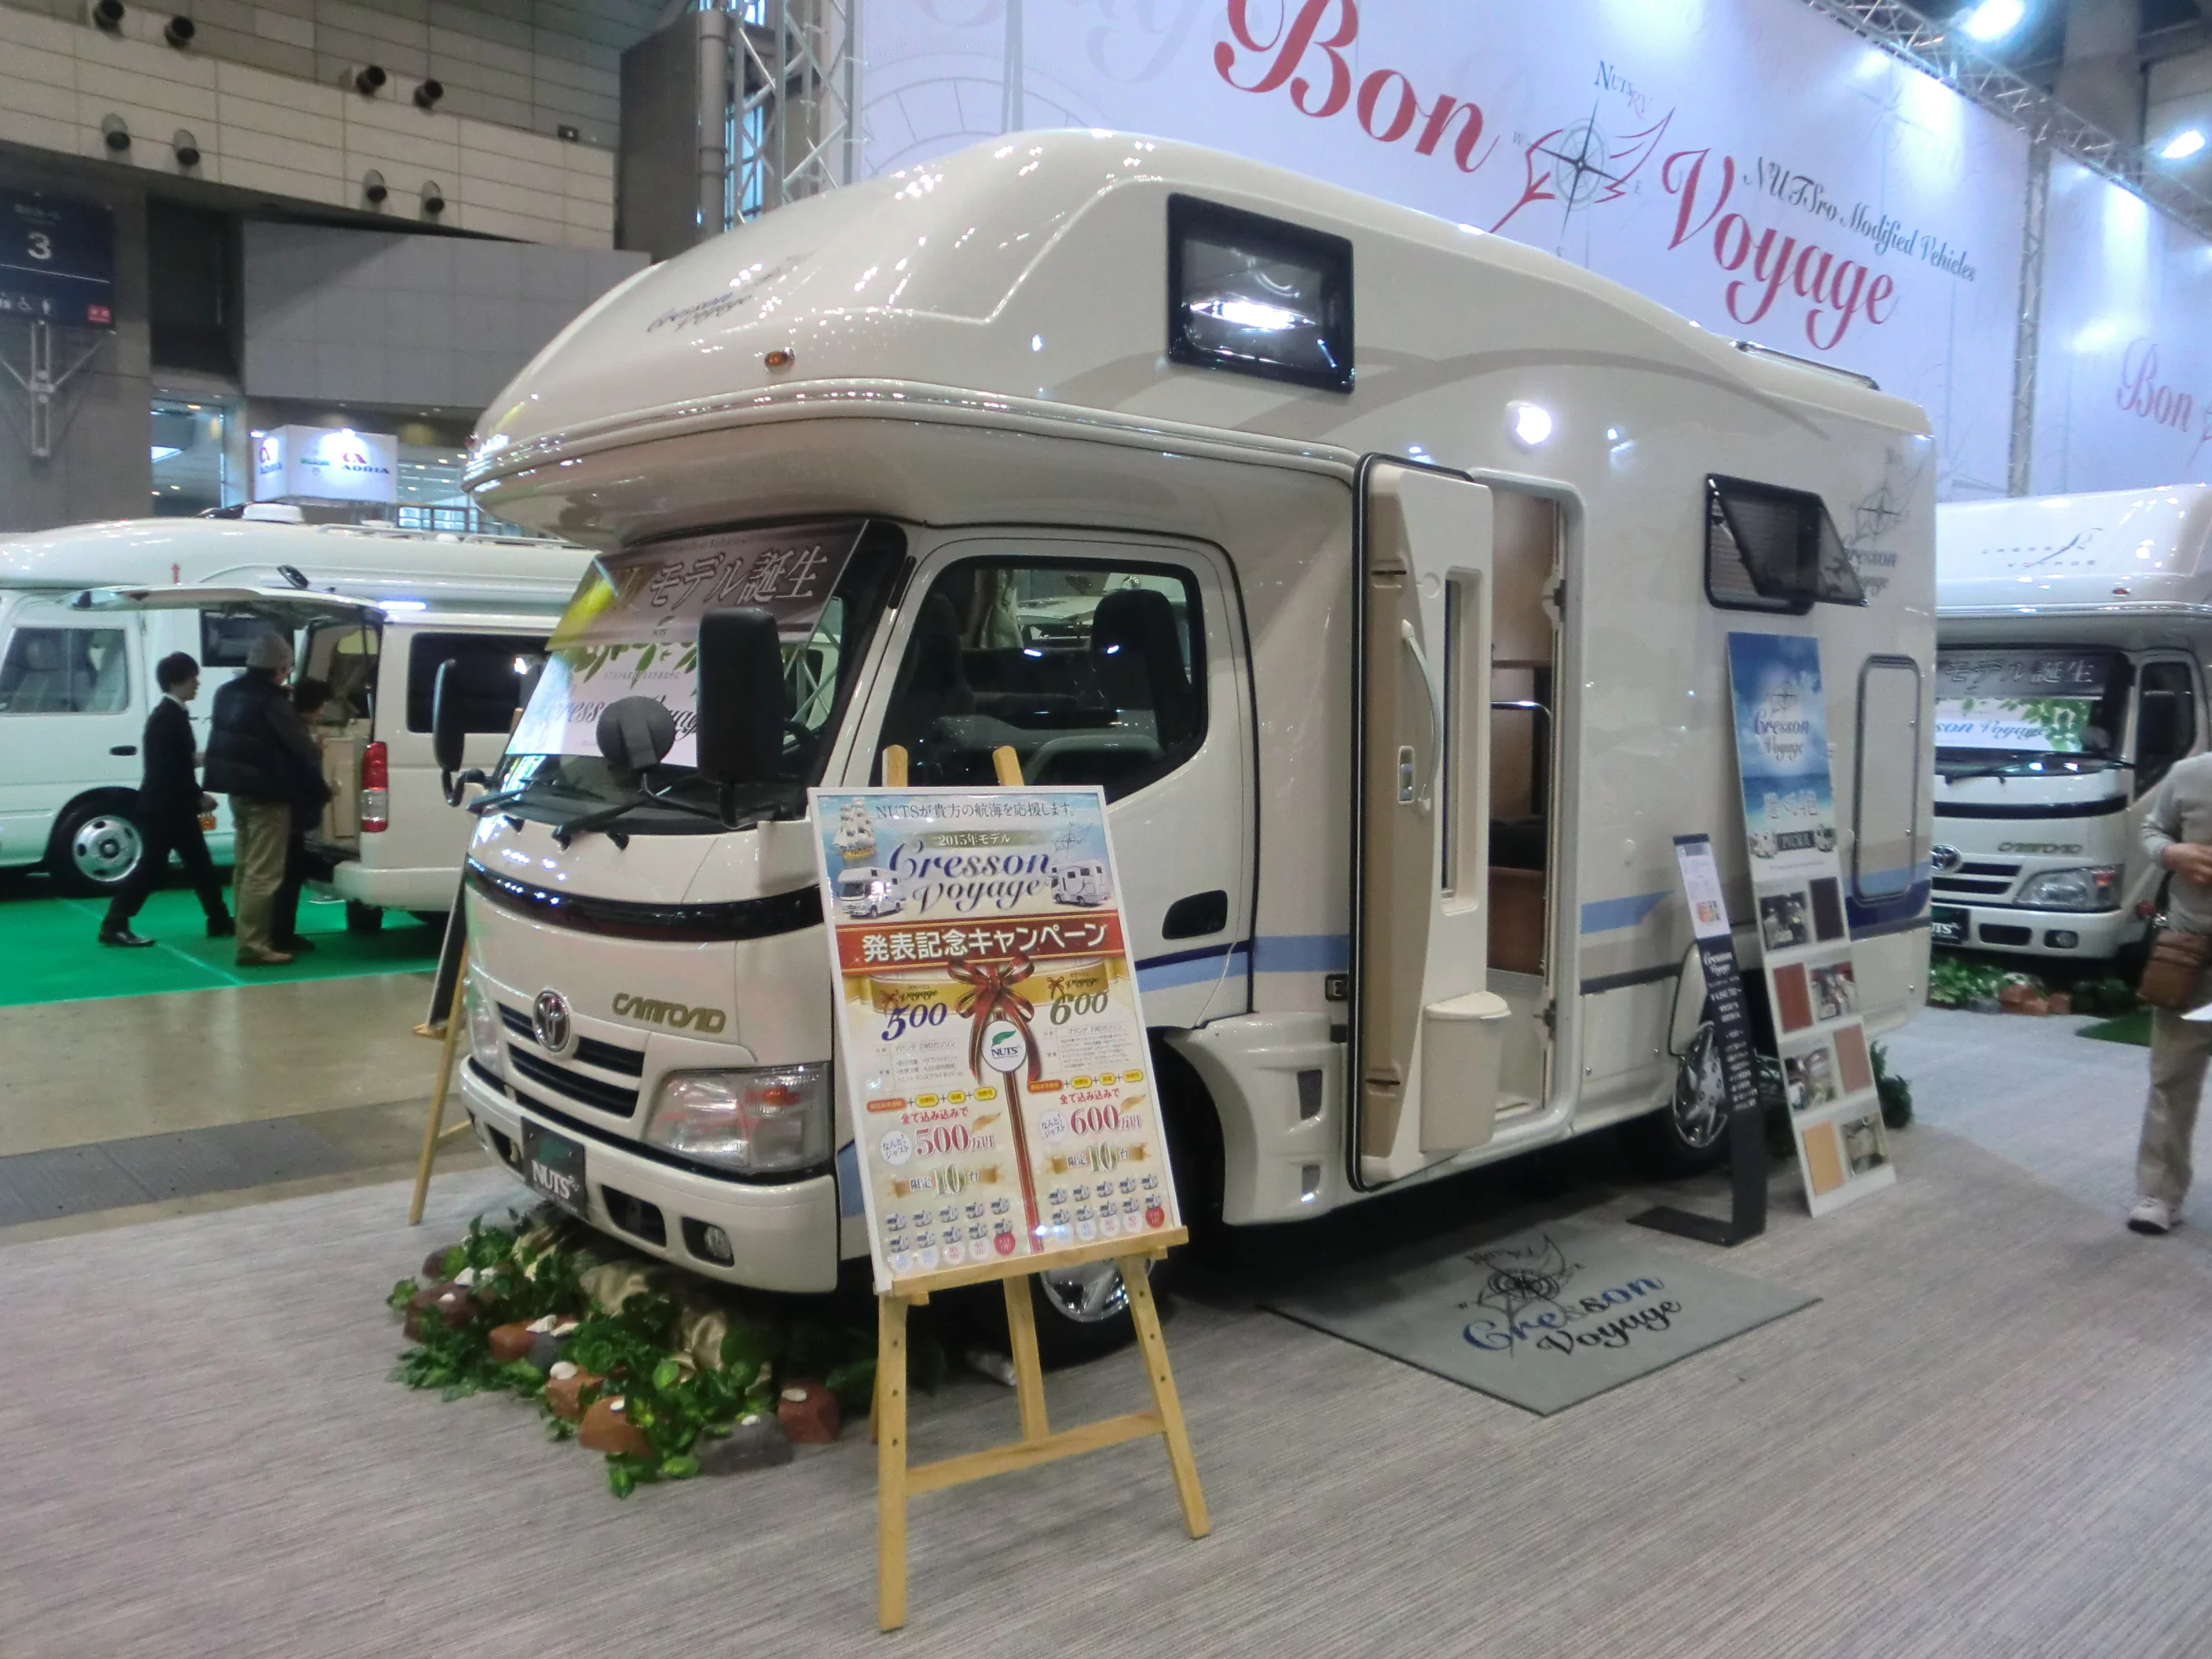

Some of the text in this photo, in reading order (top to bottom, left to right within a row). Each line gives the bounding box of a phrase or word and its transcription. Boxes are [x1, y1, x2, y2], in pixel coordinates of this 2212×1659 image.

[1214, 0, 1500, 173] Bon
[27, 232, 52, 260] 3
[1662, 148, 1899, 350] Voyage
[1840, 201, 1920, 256] Modified
[1921, 235, 1976, 281] Vehicles
[2116, 338, 2193, 433] Bon
[342, 464, 390, 474] ADRIA
[650, 546, 827, 611] モデル誕生
[939, 833, 1012, 846] 2015年モデル
[888, 840, 1050, 881] Cresson
[911, 877, 1046, 914] Voyage
[862, 922, 1107, 964] 発表記念キャンペーン
[881, 1002, 947, 1041] 500
[1049, 990, 1109, 1025] 600
[991, 1046, 1018, 1057] NUTS
[900, 1106, 969, 1125] 全て込み込みで
[1059, 1087, 1120, 1105] 全て込み込みで
[531, 1159, 570, 1199] NUTS
[1536, 1300, 1683, 1356] Voyage
